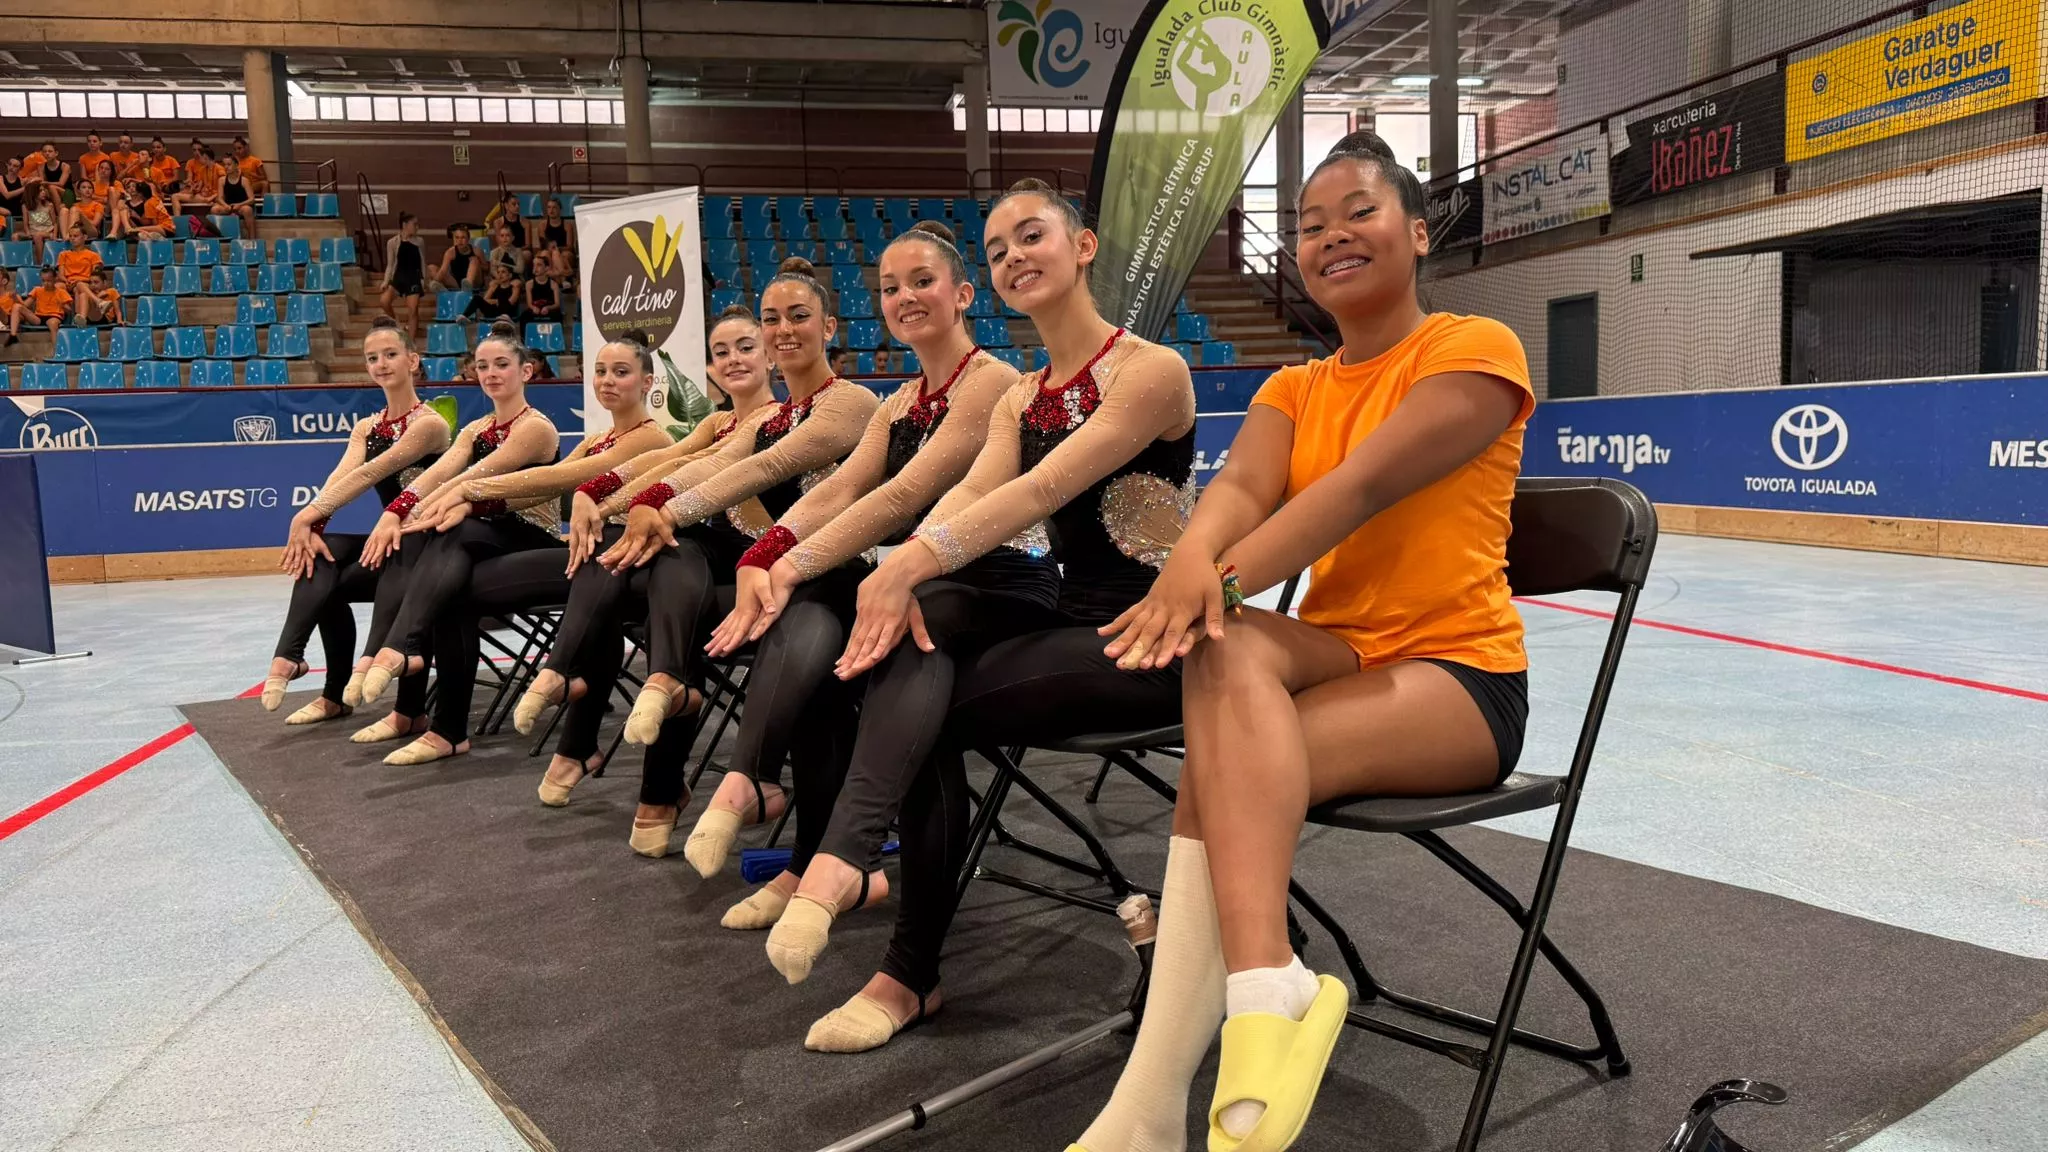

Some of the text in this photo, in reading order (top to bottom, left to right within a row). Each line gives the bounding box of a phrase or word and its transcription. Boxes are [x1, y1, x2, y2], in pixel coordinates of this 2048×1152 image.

[1150, 0, 1290, 91] Igualada Club Gimnàstic
[1884, 16, 1977, 62] Garatge
[1884, 39, 2003, 91] Verdaguer
[1652, 100, 1717, 136] xarcuteria
[1652, 122, 1734, 193] Ibañez
[1125, 138, 1199, 283] GIMNÀSTICA RÍTMICA
[1150, 208, 1185, 270] ESTÈTICA
[1180, 186, 1196, 207] DE
[1190, 146, 1214, 186] GRUP
[600, 274, 678, 316] cal tino
[1744, 476, 1877, 497] TOYOTA IGUALADA
